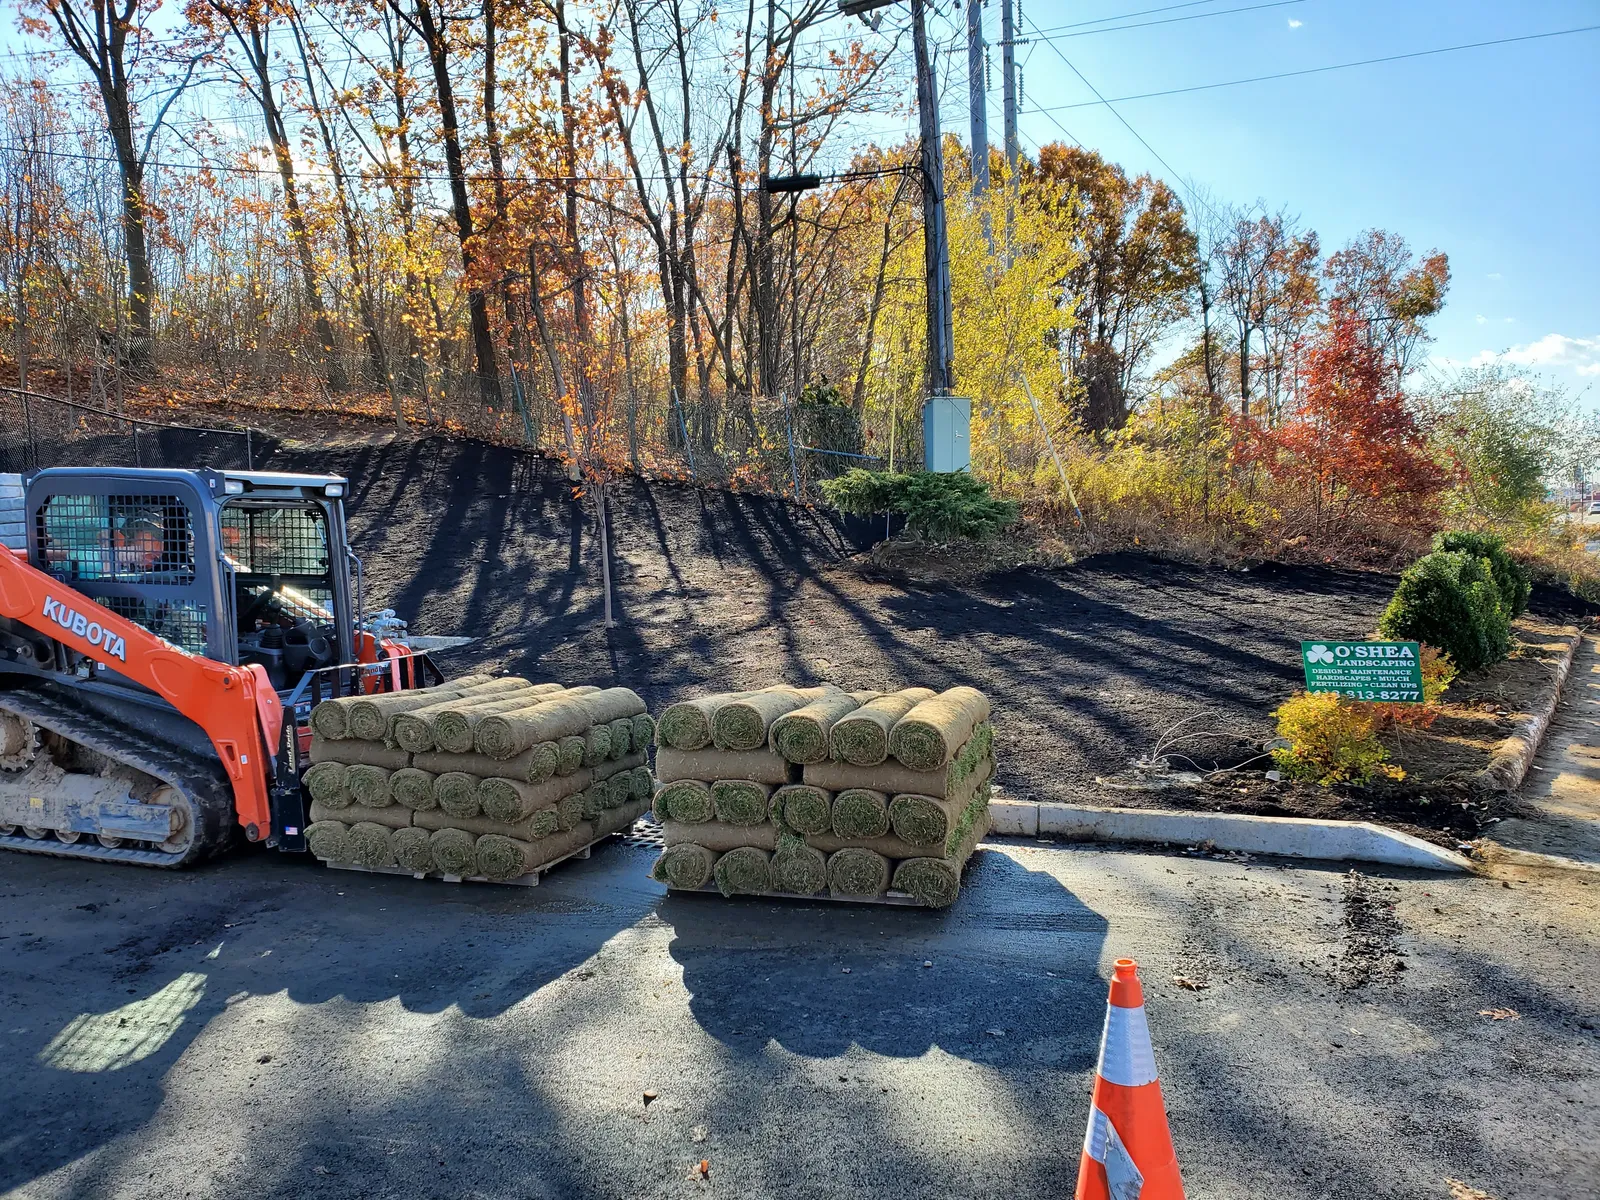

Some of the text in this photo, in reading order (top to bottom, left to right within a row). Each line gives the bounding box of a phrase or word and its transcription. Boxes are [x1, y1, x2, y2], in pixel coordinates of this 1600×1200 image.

[43, 595, 126, 662] KUBOTA
[1335, 645, 1415, 658] O'SHEA
[1336, 659, 1416, 667] LANDSCAPING
